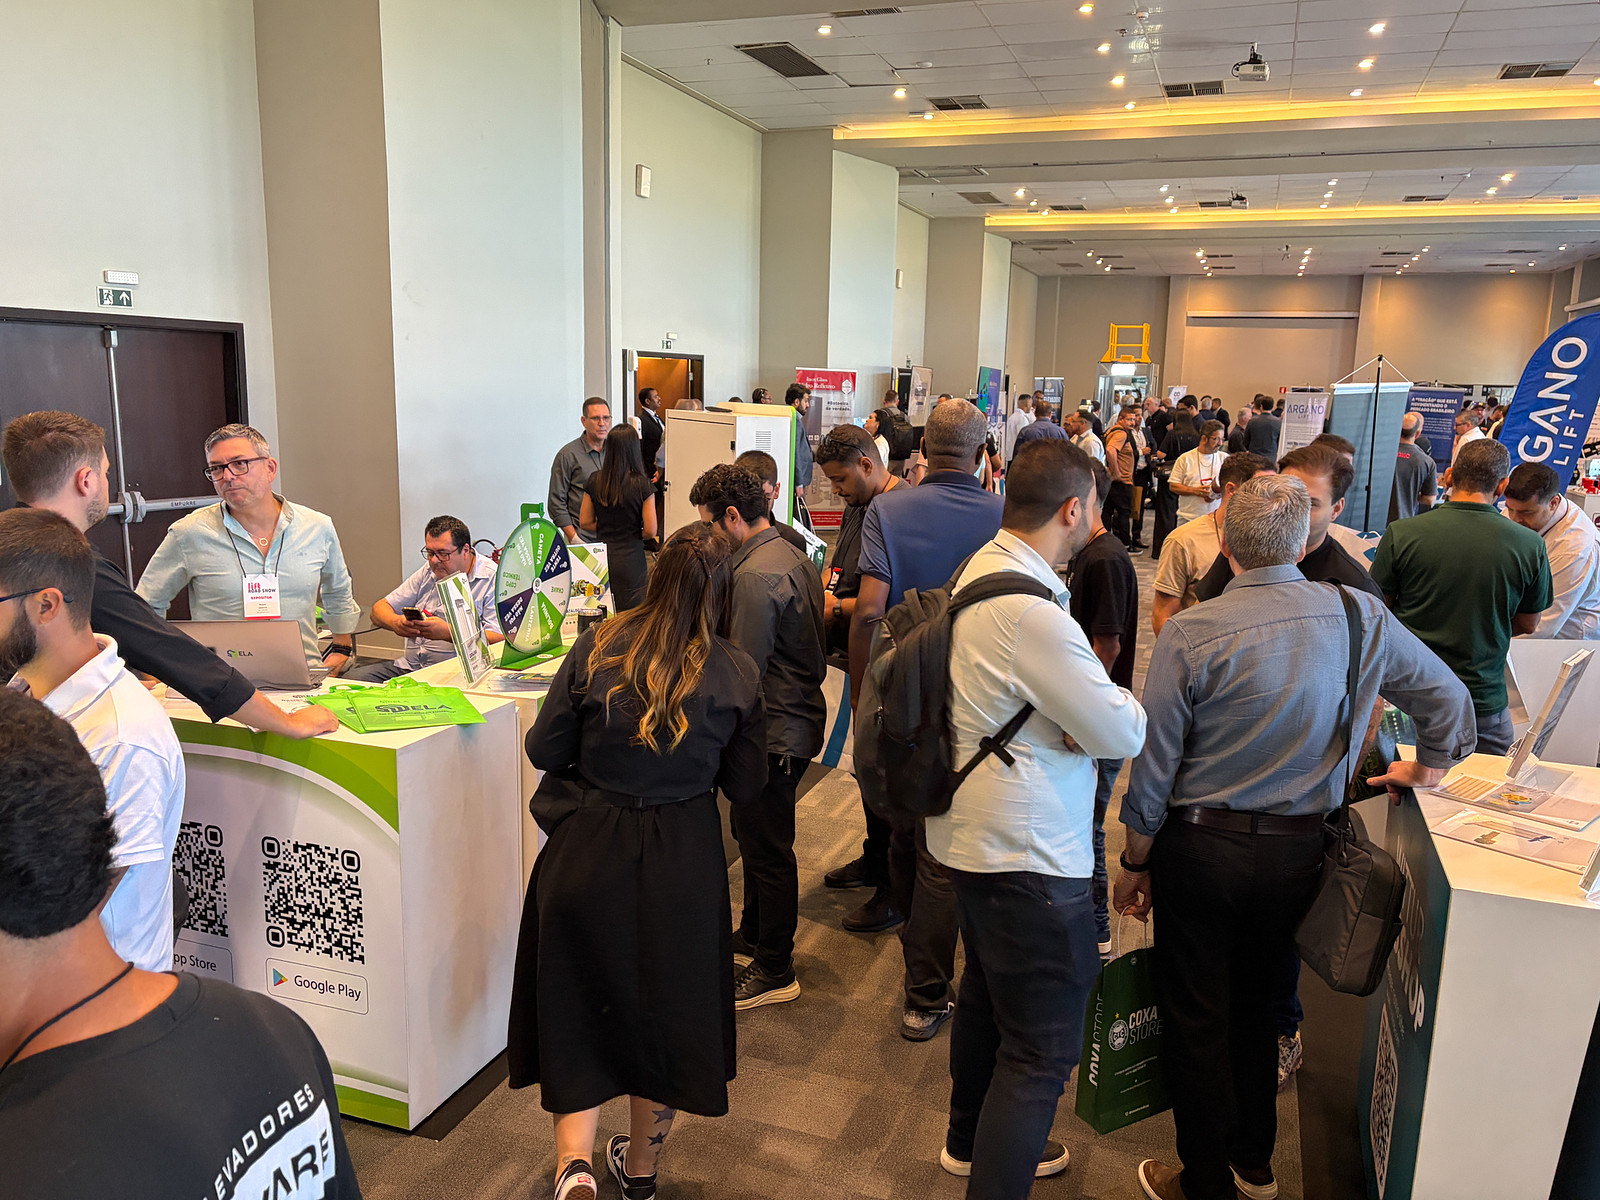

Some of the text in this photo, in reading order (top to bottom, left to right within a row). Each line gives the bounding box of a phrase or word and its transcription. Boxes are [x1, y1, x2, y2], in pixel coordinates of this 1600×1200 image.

[1286, 404, 1325, 415] ARGANO
[1514, 336, 1588, 464] GANO
[1553, 409, 1585, 466] LIFT
[536, 533, 545, 565] CANETA
[247, 582, 261, 590] lift
[524, 605, 535, 642] LANTERNA
[173, 953, 217, 971] pp Store
[294, 974, 361, 1002] Google Play
[1129, 1005, 1158, 1029] COXA
[1129, 1018, 1163, 1046] STORE
[203, 1083, 314, 1200] EVADORES
